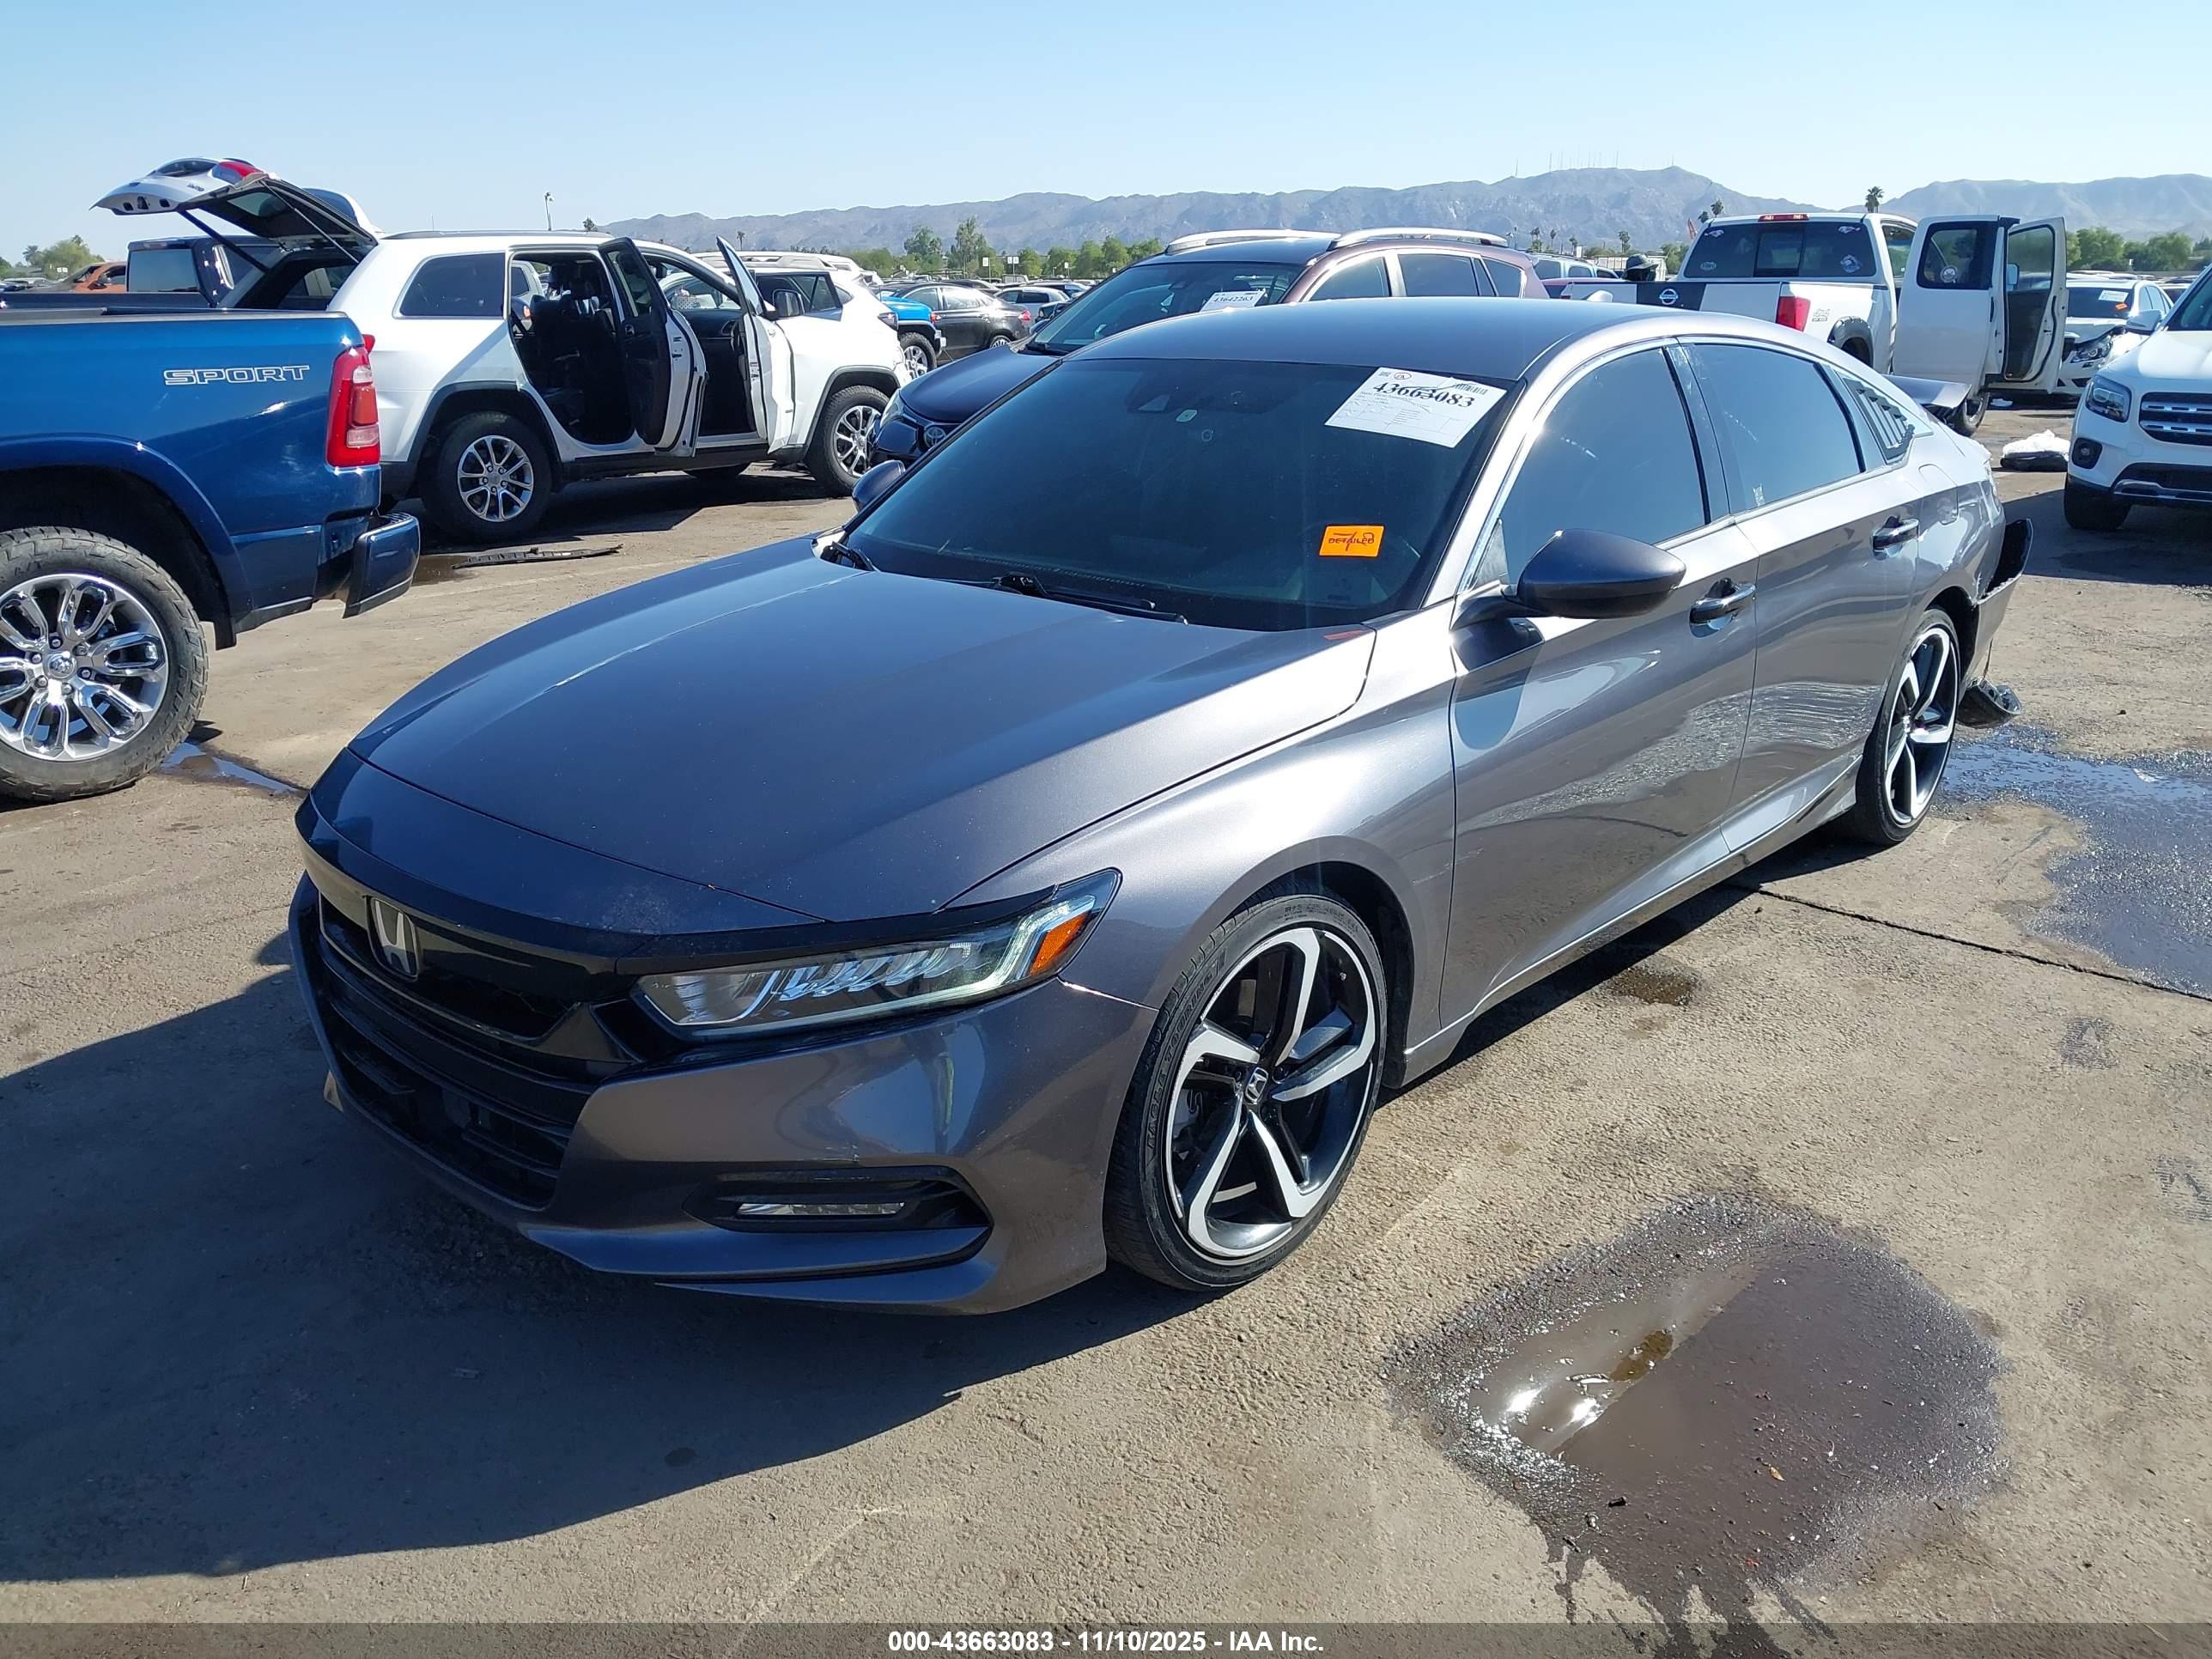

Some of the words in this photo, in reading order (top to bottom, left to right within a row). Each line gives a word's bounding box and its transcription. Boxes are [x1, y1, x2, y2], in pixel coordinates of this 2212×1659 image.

[164, 365, 310, 386] SPORT
[1373, 381, 1476, 408] 43663083
[1164, 972, 1212, 1062] TOURING
